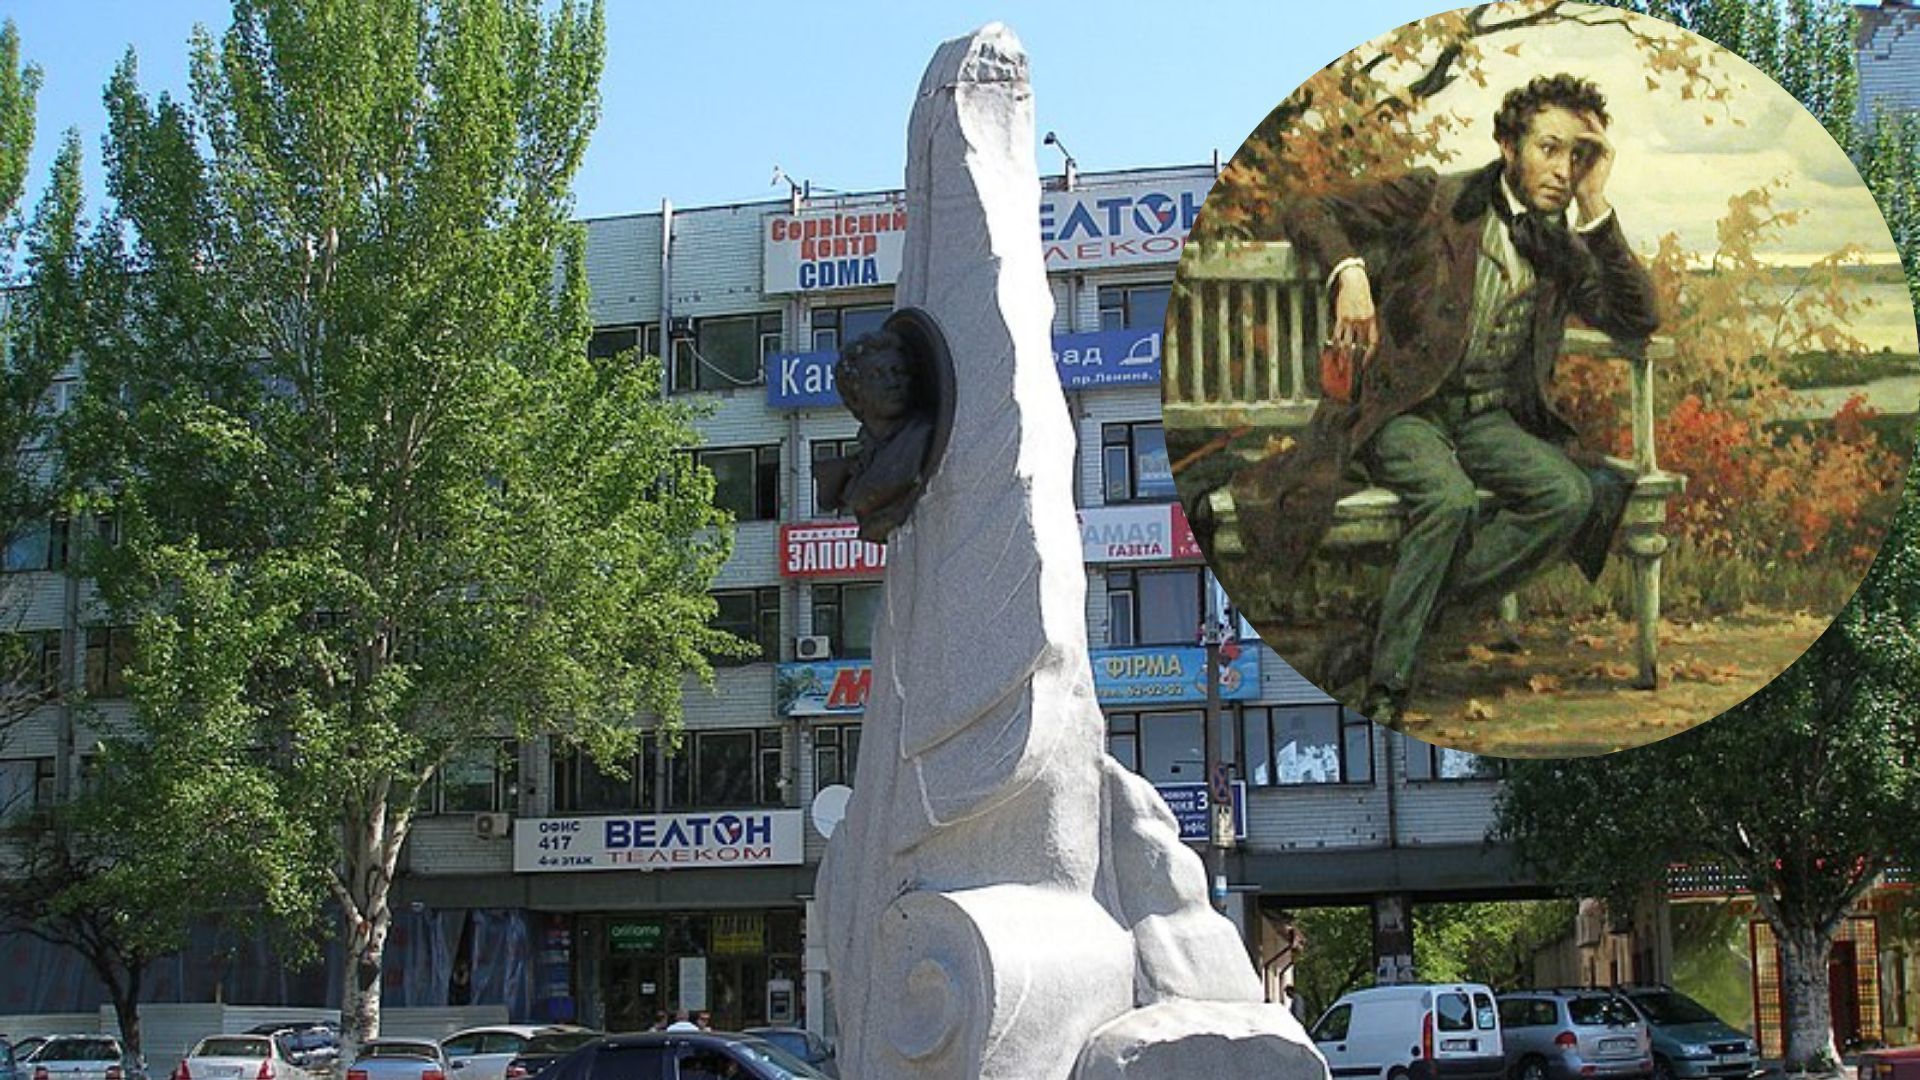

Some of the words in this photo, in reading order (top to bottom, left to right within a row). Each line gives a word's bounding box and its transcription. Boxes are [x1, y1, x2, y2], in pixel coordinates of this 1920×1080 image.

[800, 258, 879, 289] CDMA
[1108, 542, 1163, 557] ГАЗЕТА
[1106, 654, 1183, 678] ФІРМА
[539, 821, 580, 833] ОФИС
[605, 815, 771, 848] ВЕЛТОН
[538, 835, 572, 850] 417
[606, 847, 771, 863] ТЕЛЕКОМ
